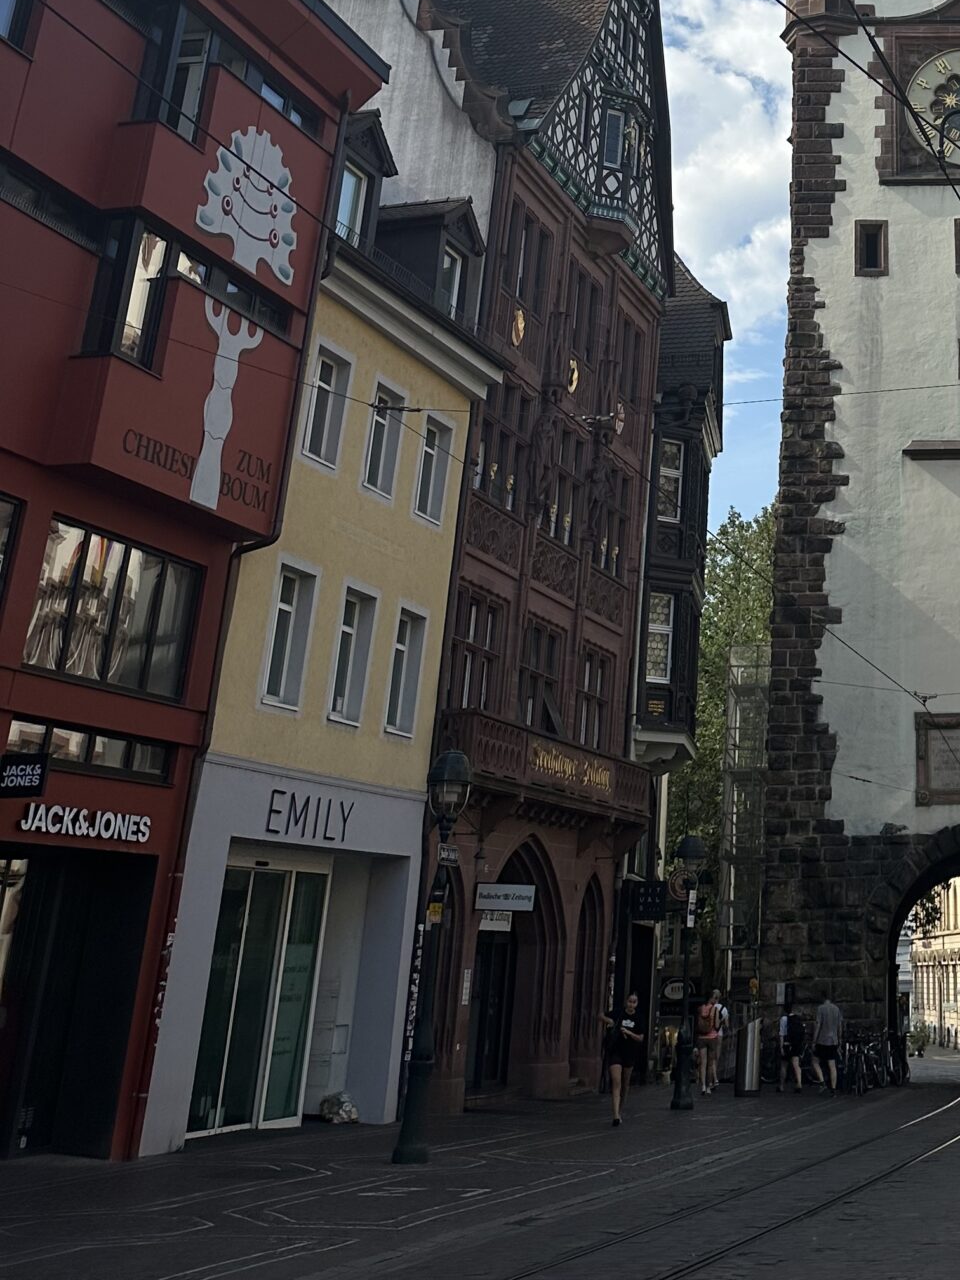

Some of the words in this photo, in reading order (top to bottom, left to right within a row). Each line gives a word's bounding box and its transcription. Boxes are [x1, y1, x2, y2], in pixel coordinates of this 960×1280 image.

[236, 449, 273, 484] ZUM
[220, 472, 269, 512] BOUM
[0, 774, 40, 787] JONES
[2, 763, 42, 777] JACK&
[20, 802, 151, 843] JACK&JONES
[265, 788, 355, 843] EMILY
